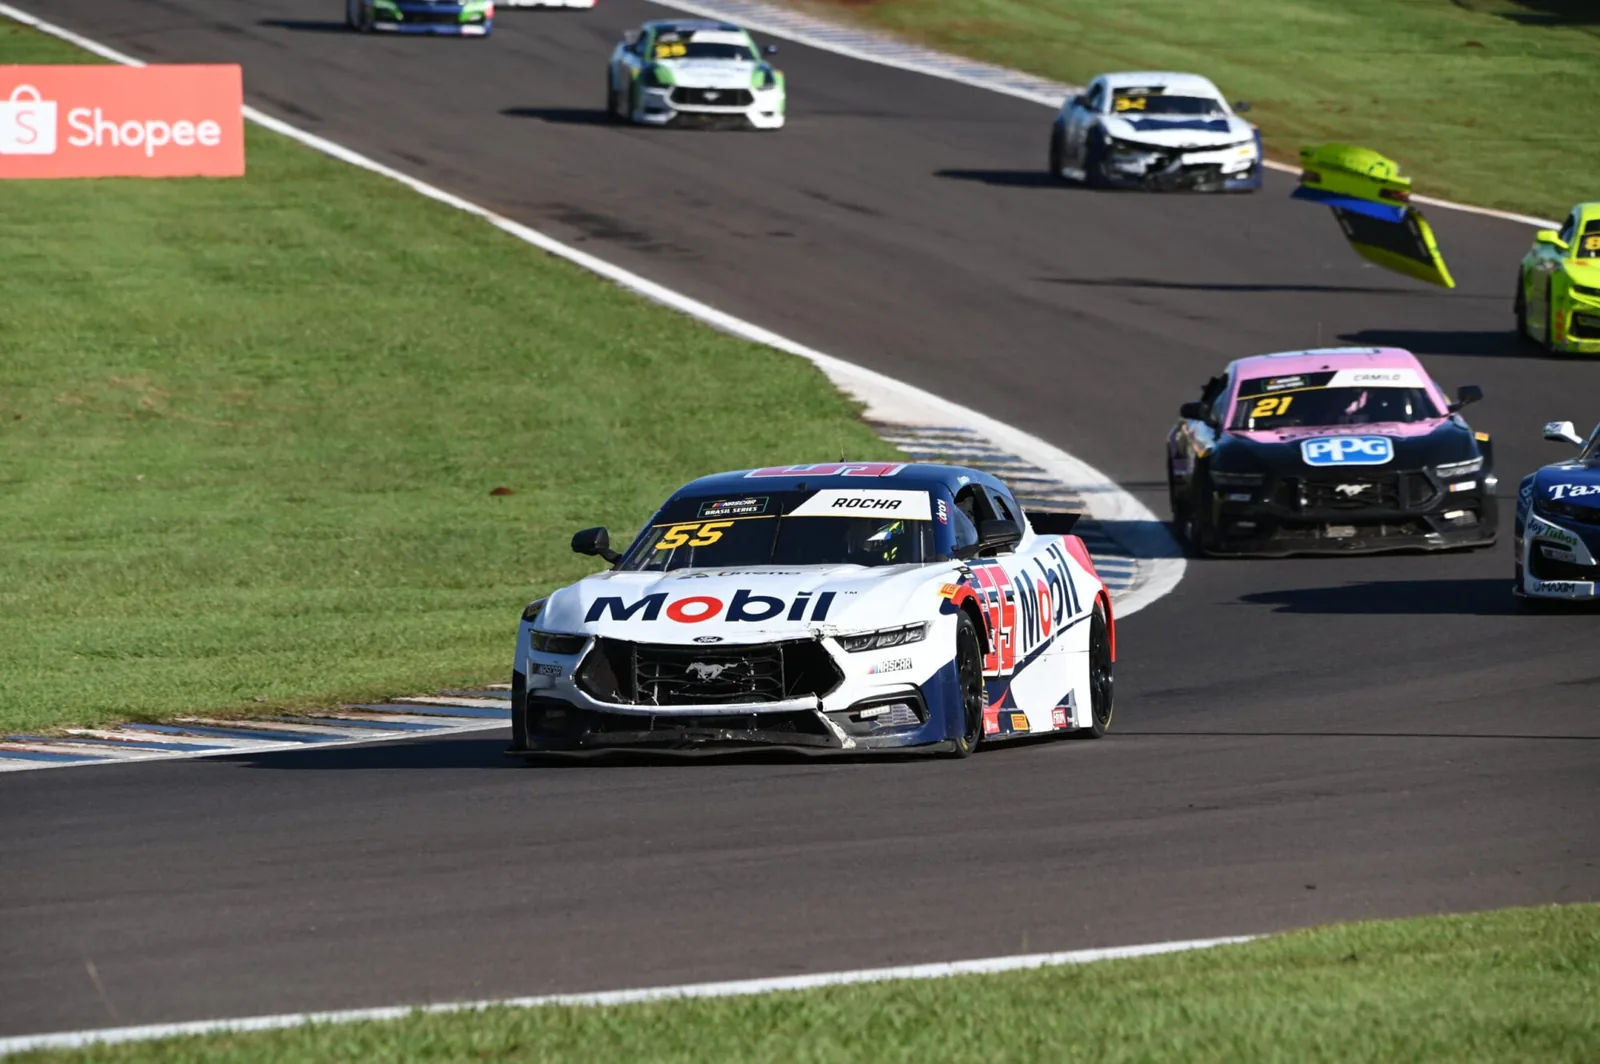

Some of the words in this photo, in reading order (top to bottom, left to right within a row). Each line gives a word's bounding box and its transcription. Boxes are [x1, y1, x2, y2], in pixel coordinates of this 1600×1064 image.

[67, 107, 221, 158] Shopee
[1353, 374, 1402, 382] CAMILO
[1250, 396, 1294, 418] 21
[1305, 436, 1388, 461] PPG
[732, 506, 758, 514] SERIES
[831, 497, 903, 510] ROCHA
[654, 521, 735, 550] 55
[584, 588, 837, 624] Mobil
[1014, 542, 1083, 654] Mobil
[877, 657, 913, 674] NASCAR
